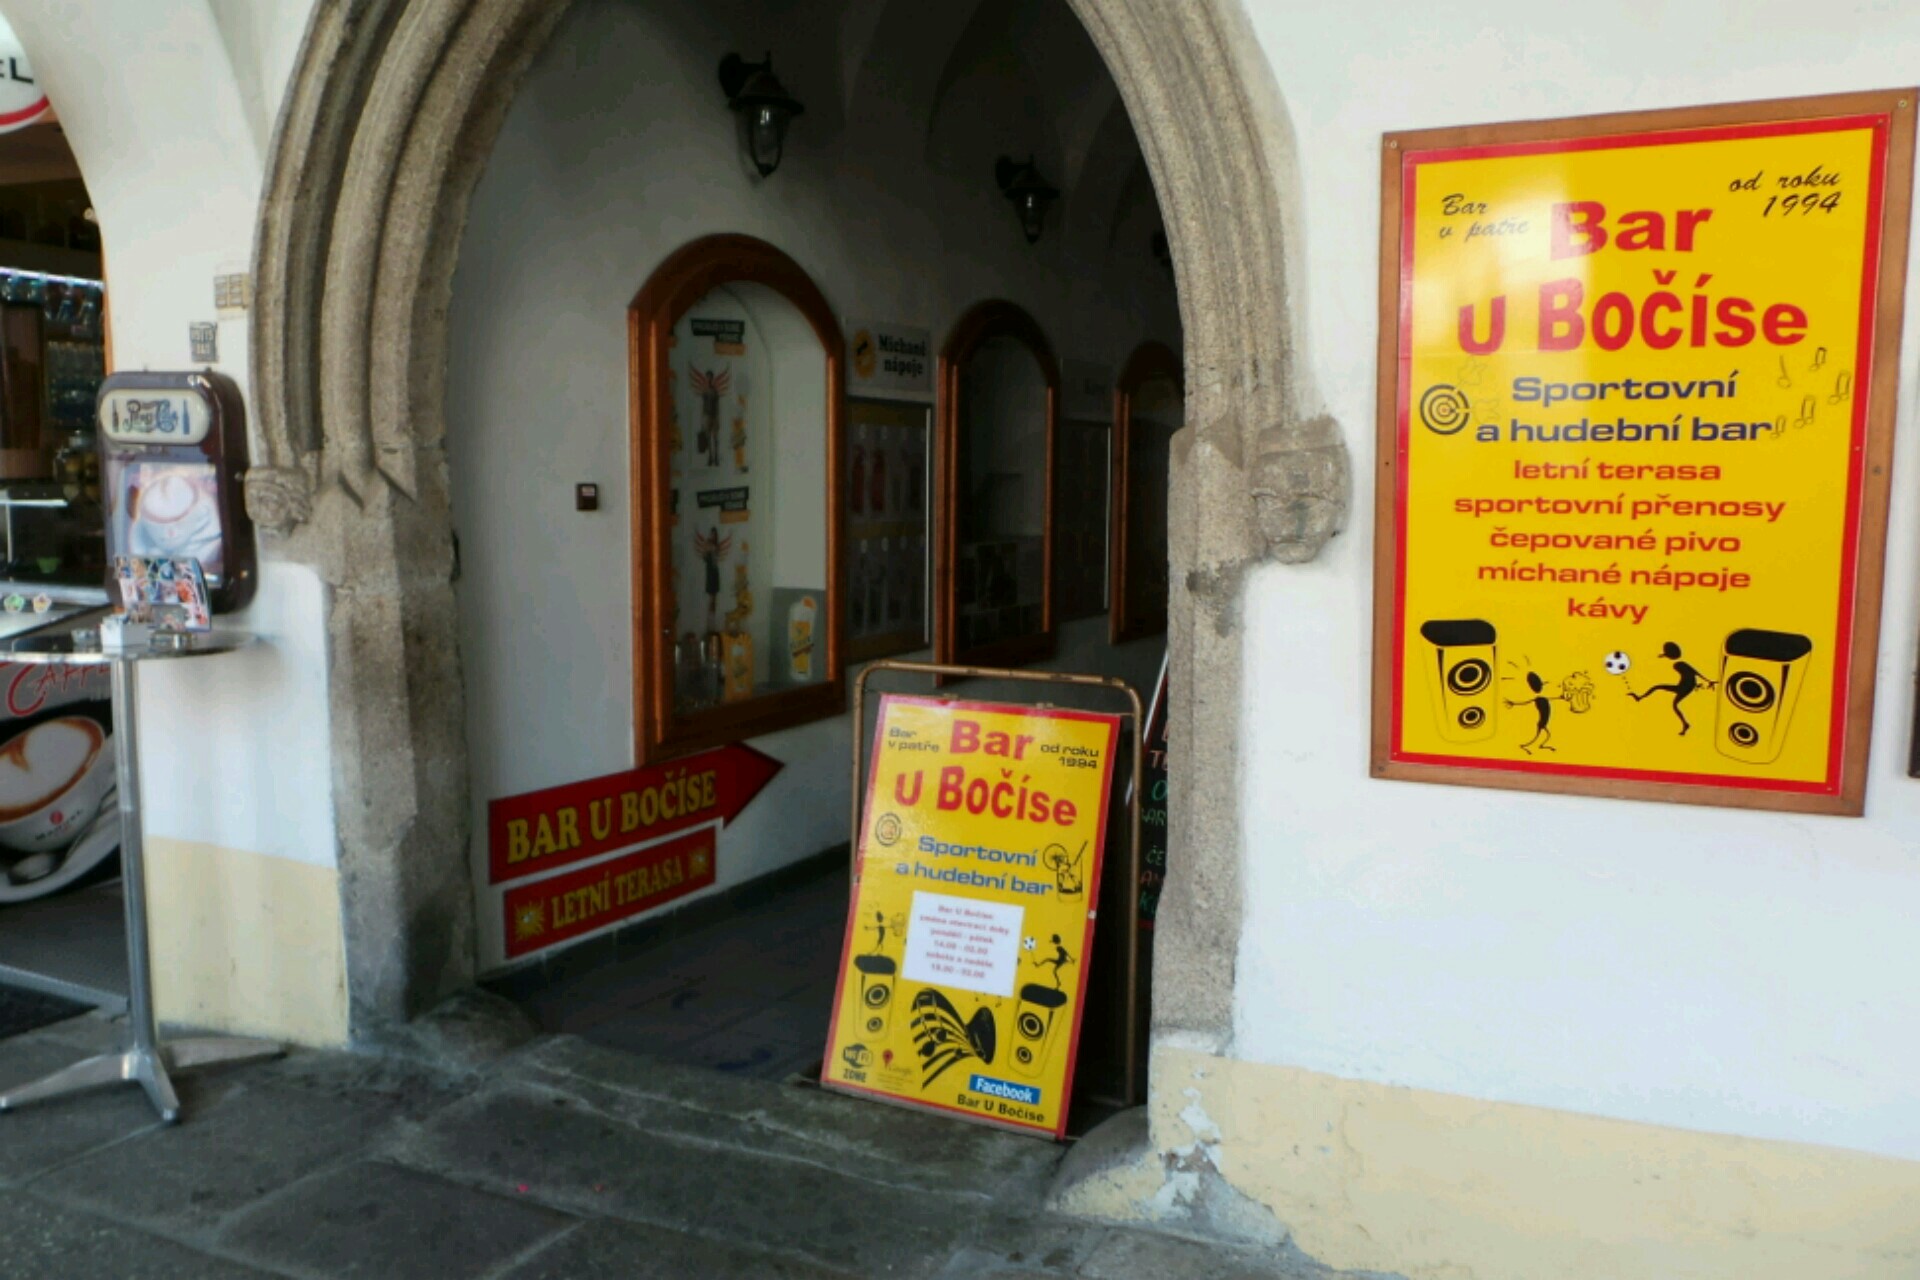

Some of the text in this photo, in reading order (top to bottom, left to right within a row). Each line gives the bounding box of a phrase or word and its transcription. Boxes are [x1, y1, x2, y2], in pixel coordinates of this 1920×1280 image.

[1728, 165, 1841, 192] od roku
[1442, 193, 1488, 216] Bar
[1763, 191, 1842, 217] 1994
[1464, 217, 1530, 243] patře
[1550, 201, 1713, 260] Bar
[1538, 269, 1809, 352] Bočíse
[1512, 369, 1737, 407] Sportovní
[1476, 414, 1772, 443] a hudební bar
[1514, 458, 1721, 481] letní terasa
[1454, 492, 1786, 523] sportovní přenosy
[1490, 527, 1741, 555] čepované pivo
[1478, 562, 1751, 592] míchané nápoje
[1567, 597, 1649, 624] kávy
[889, 726, 917, 738] Bar
[898, 739, 940, 753] patře
[949, 719, 1035, 761] Bar
[1040, 744, 1100, 758] od roku
[936, 765, 1078, 826] Bočíse
[507, 768, 717, 864] BAR U BOČÍSE
[918, 836, 1040, 867] Sportovní
[895, 857, 1054, 896] a hudební bar
[551, 856, 684, 929] LETNÍ TERASA
[957, 1094, 979, 1107] Bar
[984, 1100, 994, 1111] U
[976, 1078, 1033, 1103] Facebook
